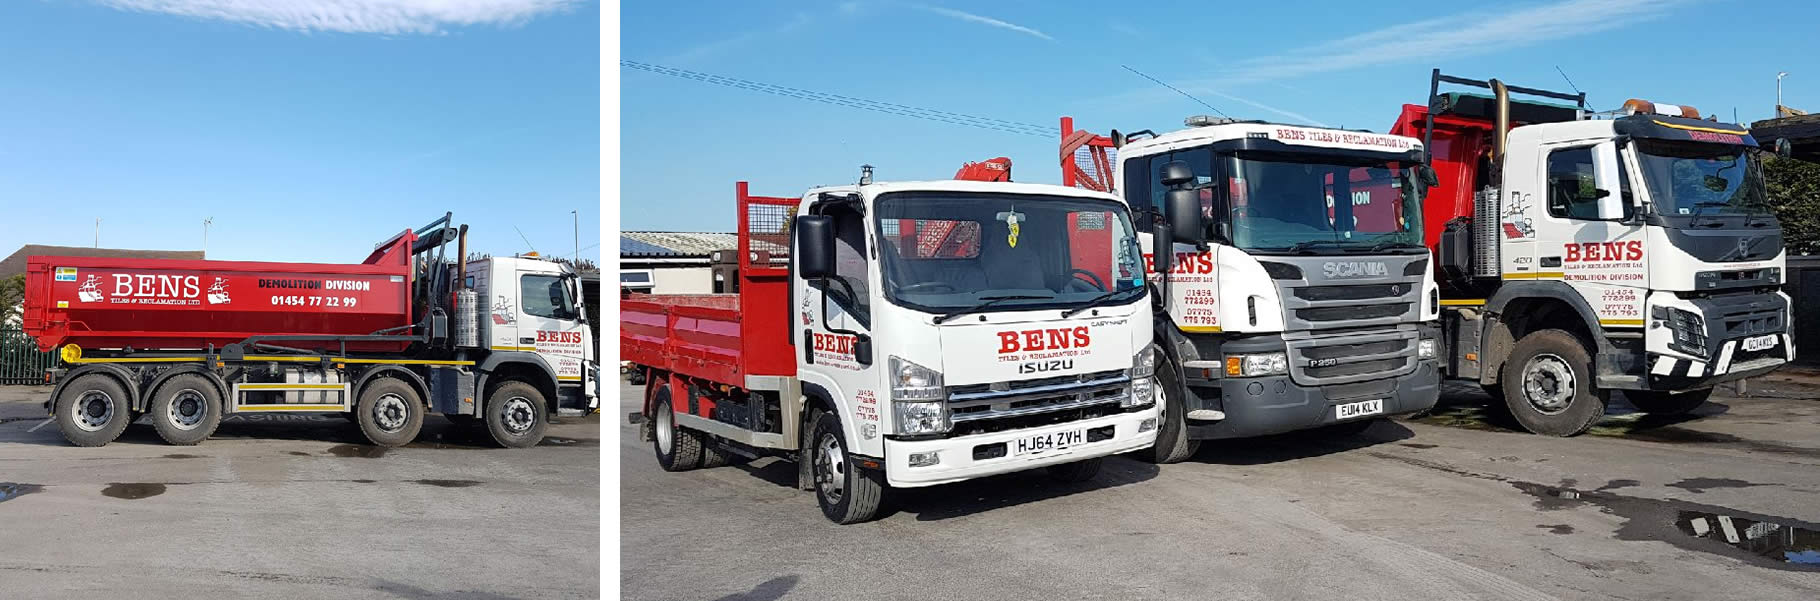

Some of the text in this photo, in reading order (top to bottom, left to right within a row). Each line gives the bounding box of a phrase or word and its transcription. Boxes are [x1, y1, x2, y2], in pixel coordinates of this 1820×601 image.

[1277, 129, 1306, 140] BENS
[1308, 131, 1333, 142] TILES
[1343, 134, 1397, 148] RECLAMATION
[1564, 240, 1643, 262] BENS
[1323, 261, 1389, 278] SCANIA
[111, 273, 200, 298] BENS
[258, 279, 370, 291] DEMOLITION DIVISION
[271, 295, 357, 307] 01454 77 22 99
[1184, 297, 1215, 305] 772299
[1183, 316, 1217, 325] 775 793
[536, 330, 582, 343] BENS
[997, 326, 1090, 354] BENS
[1019, 359, 1073, 374] ISUZU
[1018, 429, 1082, 453] HJ64 ZVH
